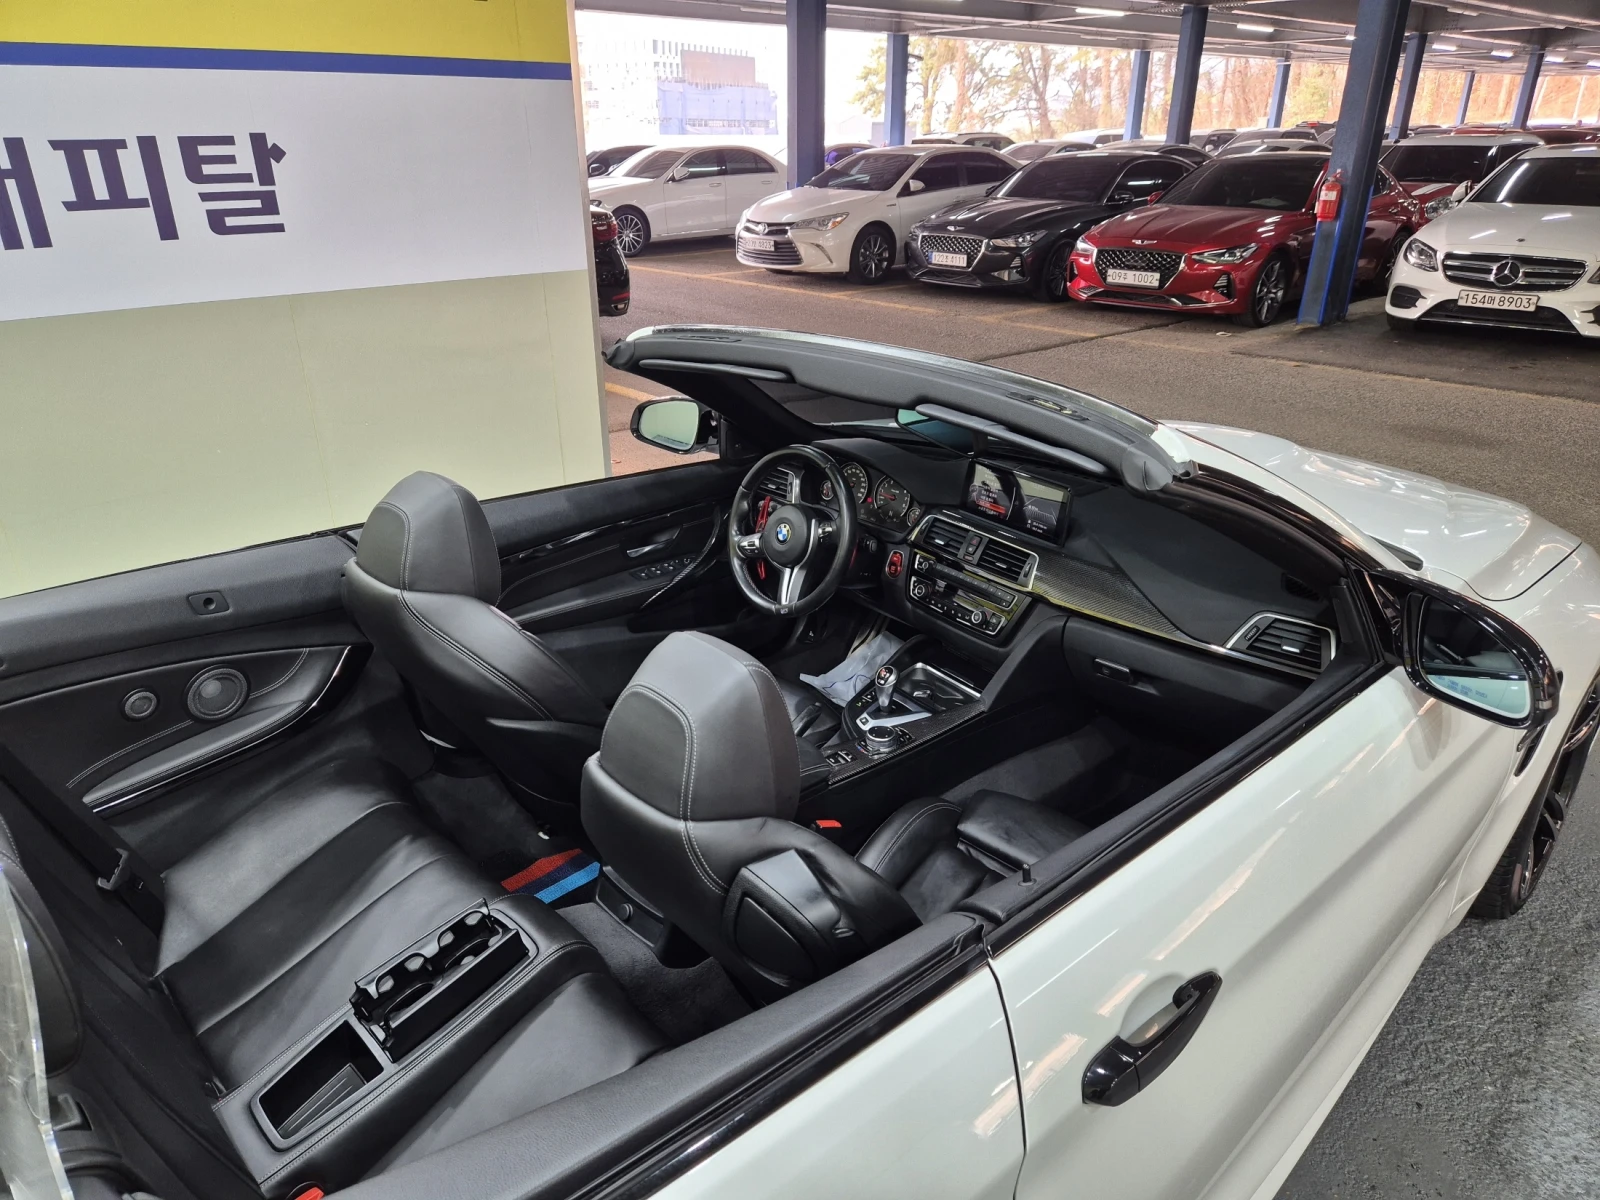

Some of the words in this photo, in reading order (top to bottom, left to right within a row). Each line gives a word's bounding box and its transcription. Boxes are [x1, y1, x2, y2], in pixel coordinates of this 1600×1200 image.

[1111, 271, 1128, 281] 09주
[1132, 273, 1155, 284] 1002
[1464, 293, 1496, 306] 154머
[1497, 295, 1532, 309] 8903
